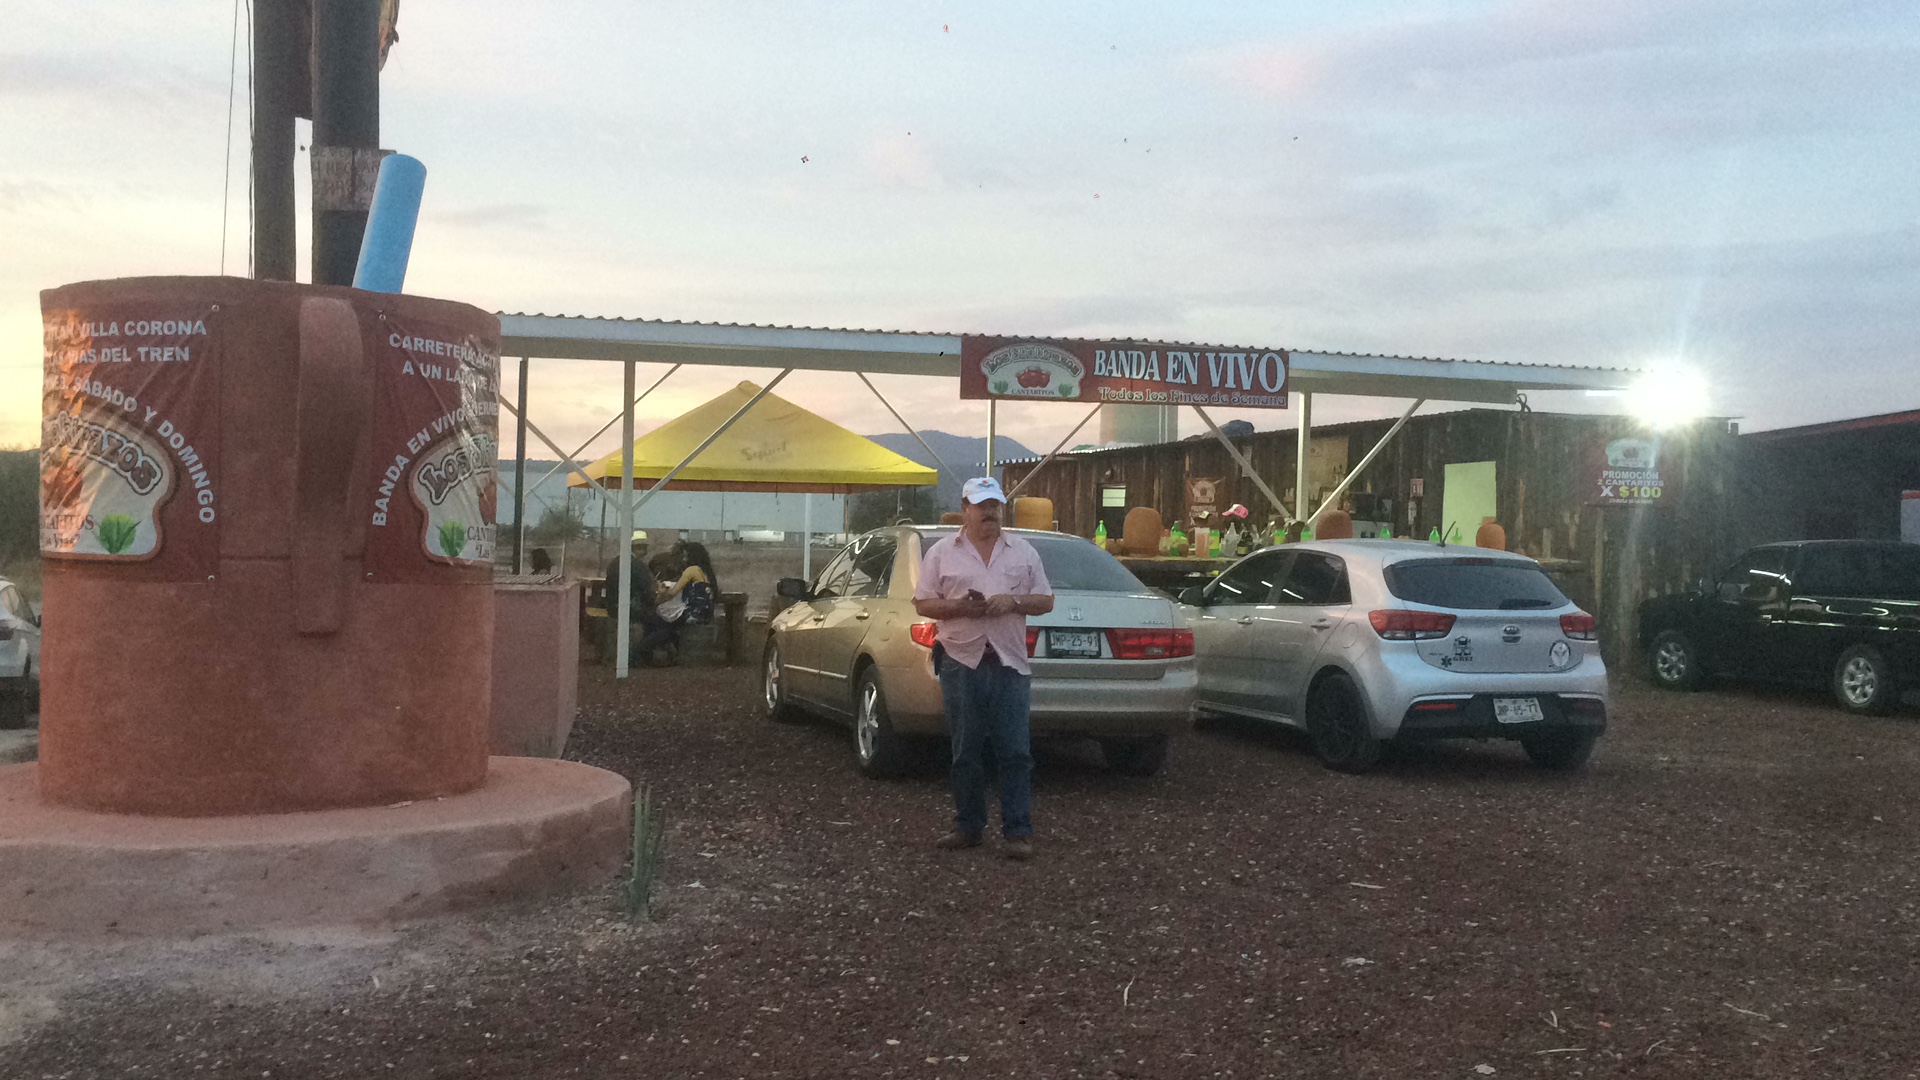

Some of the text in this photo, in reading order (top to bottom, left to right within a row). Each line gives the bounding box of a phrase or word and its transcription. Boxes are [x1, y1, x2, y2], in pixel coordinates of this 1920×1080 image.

[124, 320, 207, 336] CORONA
[101, 347, 132, 363] DEL
[137, 346, 190, 362] TREN
[402, 360, 415, 376] A
[419, 362, 442, 379] UN
[1093, 349, 1286, 394] BANDA EN VIVO
[1098, 387, 1287, 407] Todos los Fines de Semana
[73, 376, 138, 413] SABADO
[143, 405, 158, 423] Y
[157, 419, 215, 524] DOMINGO
[372, 454, 410, 526] BANDA
[406, 427, 431, 455] EN
[431, 406, 465, 434] VIVO
[1600, 485, 1662, 499] X $100
